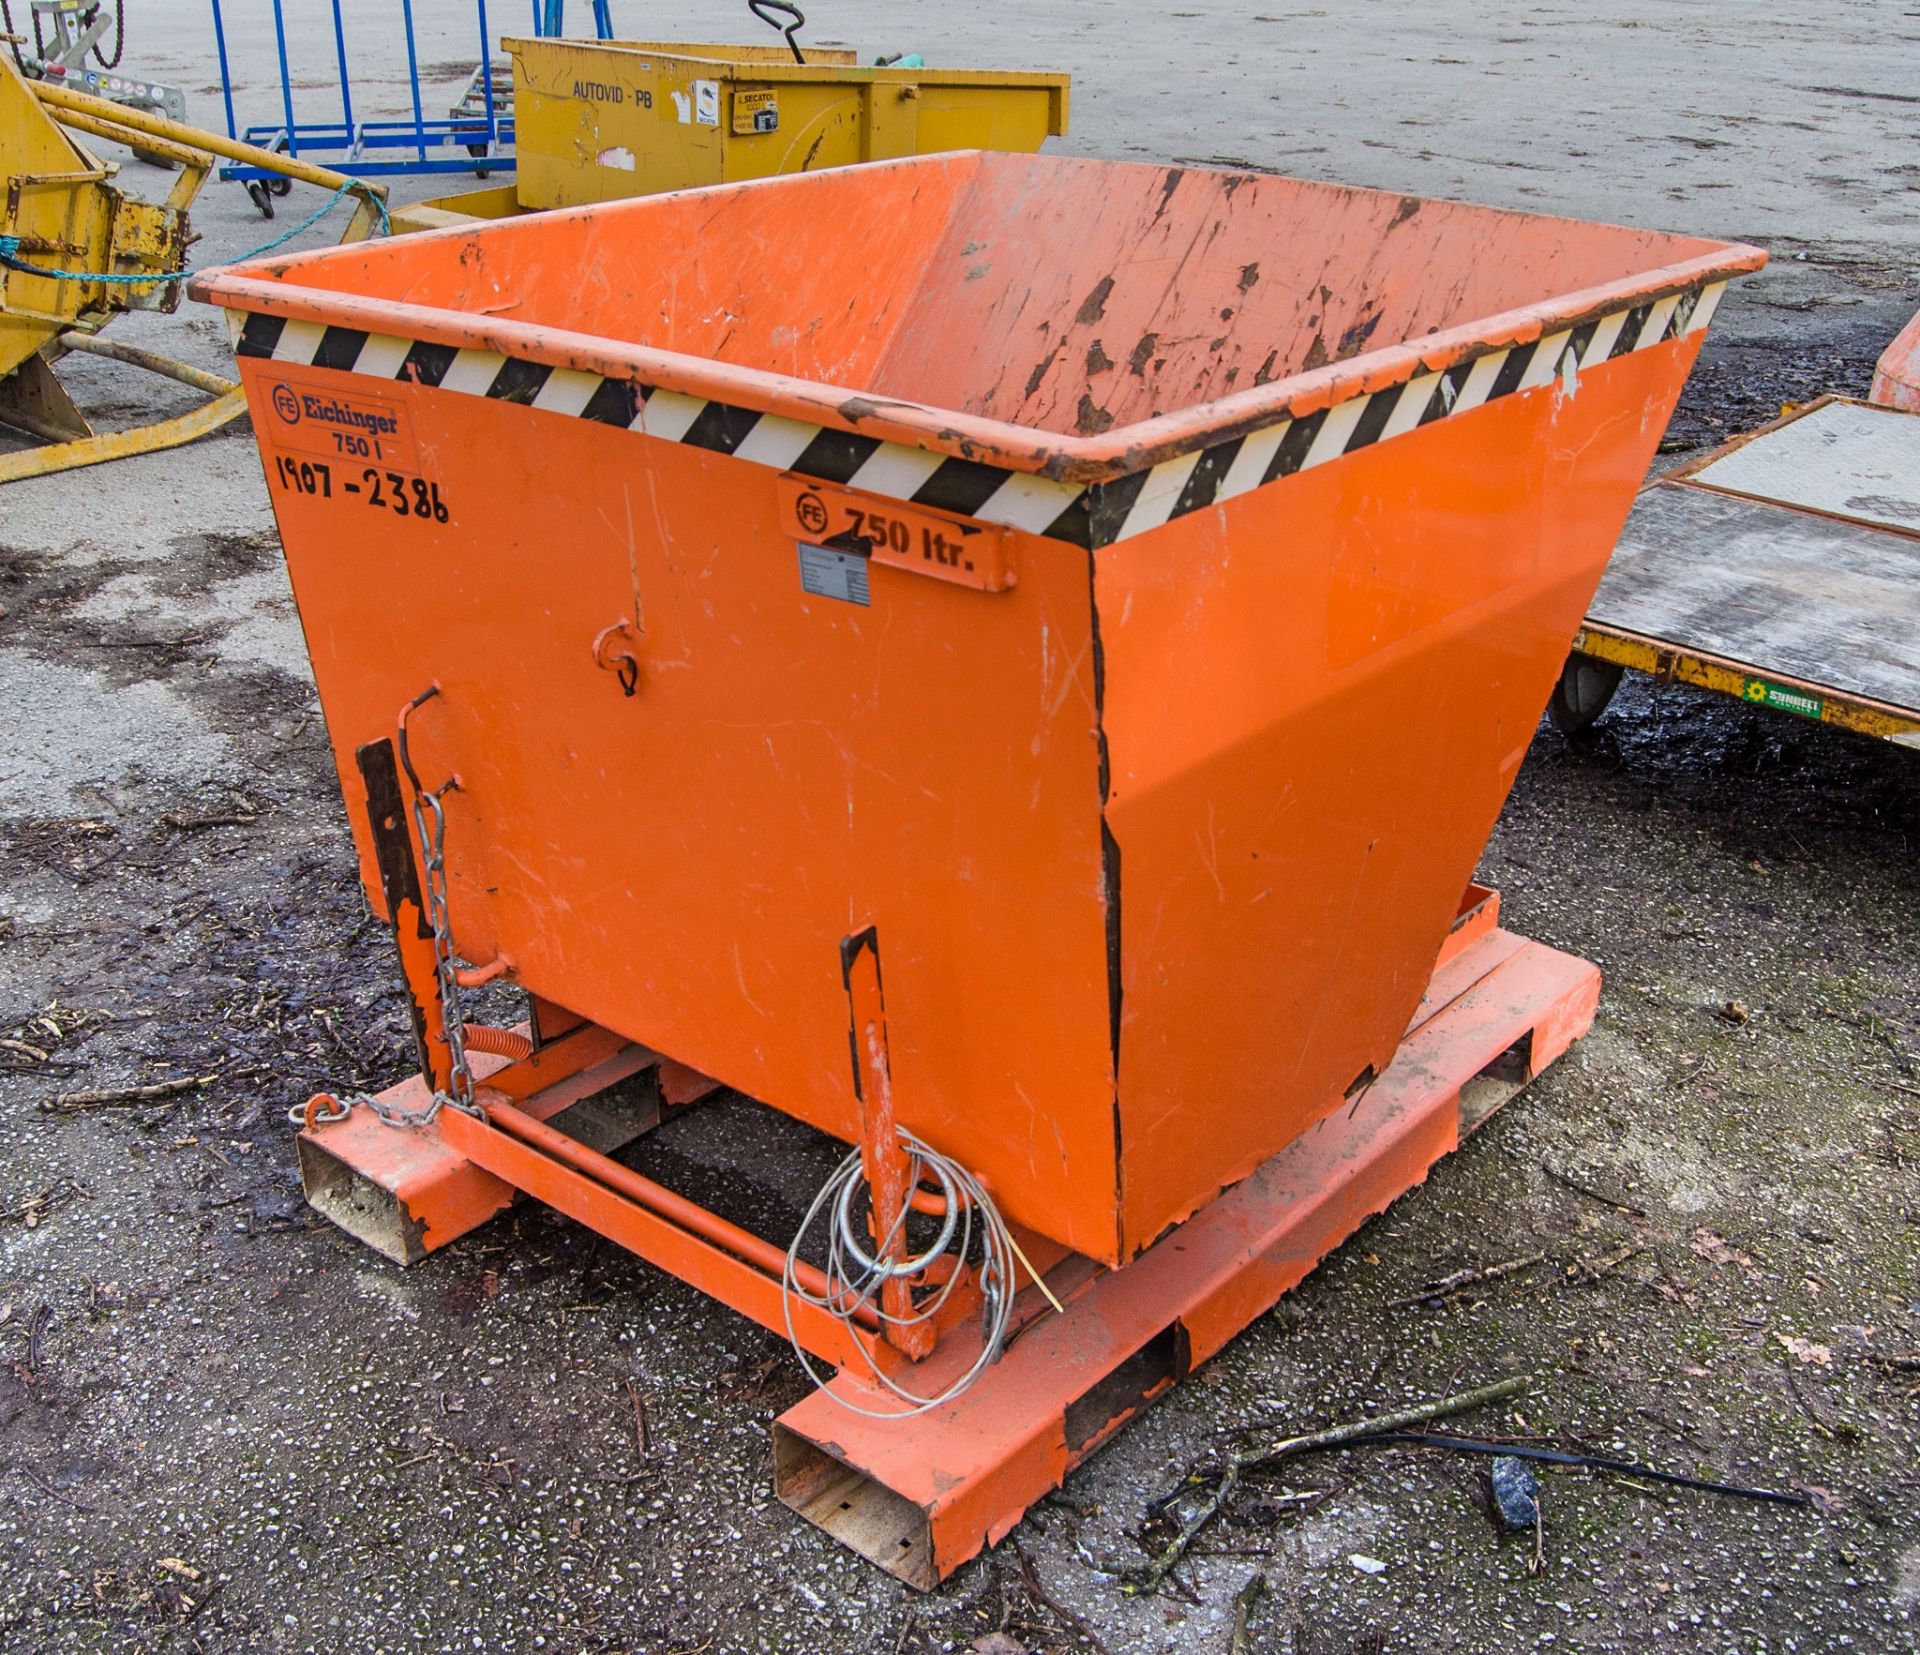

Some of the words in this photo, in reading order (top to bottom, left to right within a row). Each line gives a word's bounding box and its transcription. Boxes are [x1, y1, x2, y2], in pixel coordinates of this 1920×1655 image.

[573, 80, 624, 104] AUTOVID
[635, 90, 653, 109] PB
[301, 395, 398, 436] Eichinger
[332, 431, 370, 458] 750
[844, 507, 911, 554] 750
[922, 527, 974, 572] ltr.
[1769, 689, 1819, 711] SUNBELT
